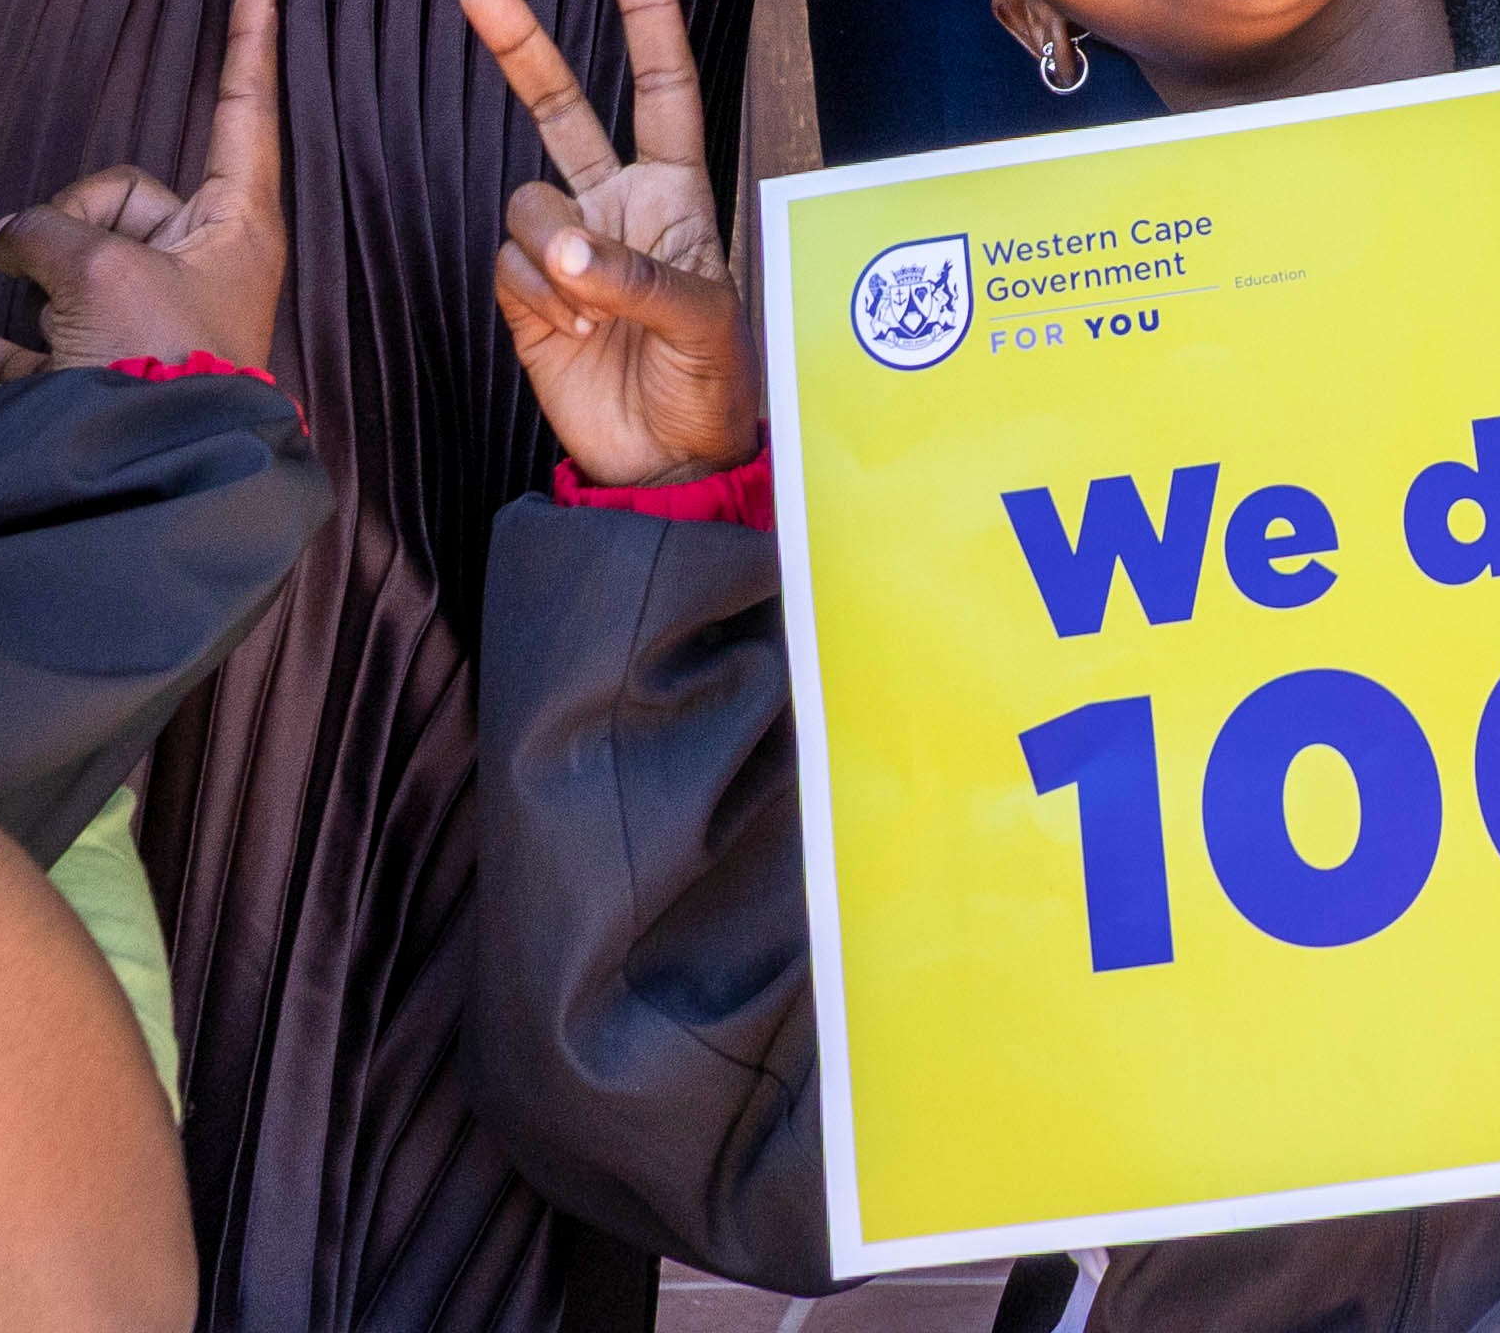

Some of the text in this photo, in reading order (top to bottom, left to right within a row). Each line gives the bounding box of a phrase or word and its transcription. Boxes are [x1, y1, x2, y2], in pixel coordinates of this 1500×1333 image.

[982, 215, 1213, 267] Western Cape
[985, 251, 1186, 303] Government
[1234, 267, 1307, 290] Education
[989, 308, 1161, 354] FOR YOU
[1001, 462, 1340, 639] We
